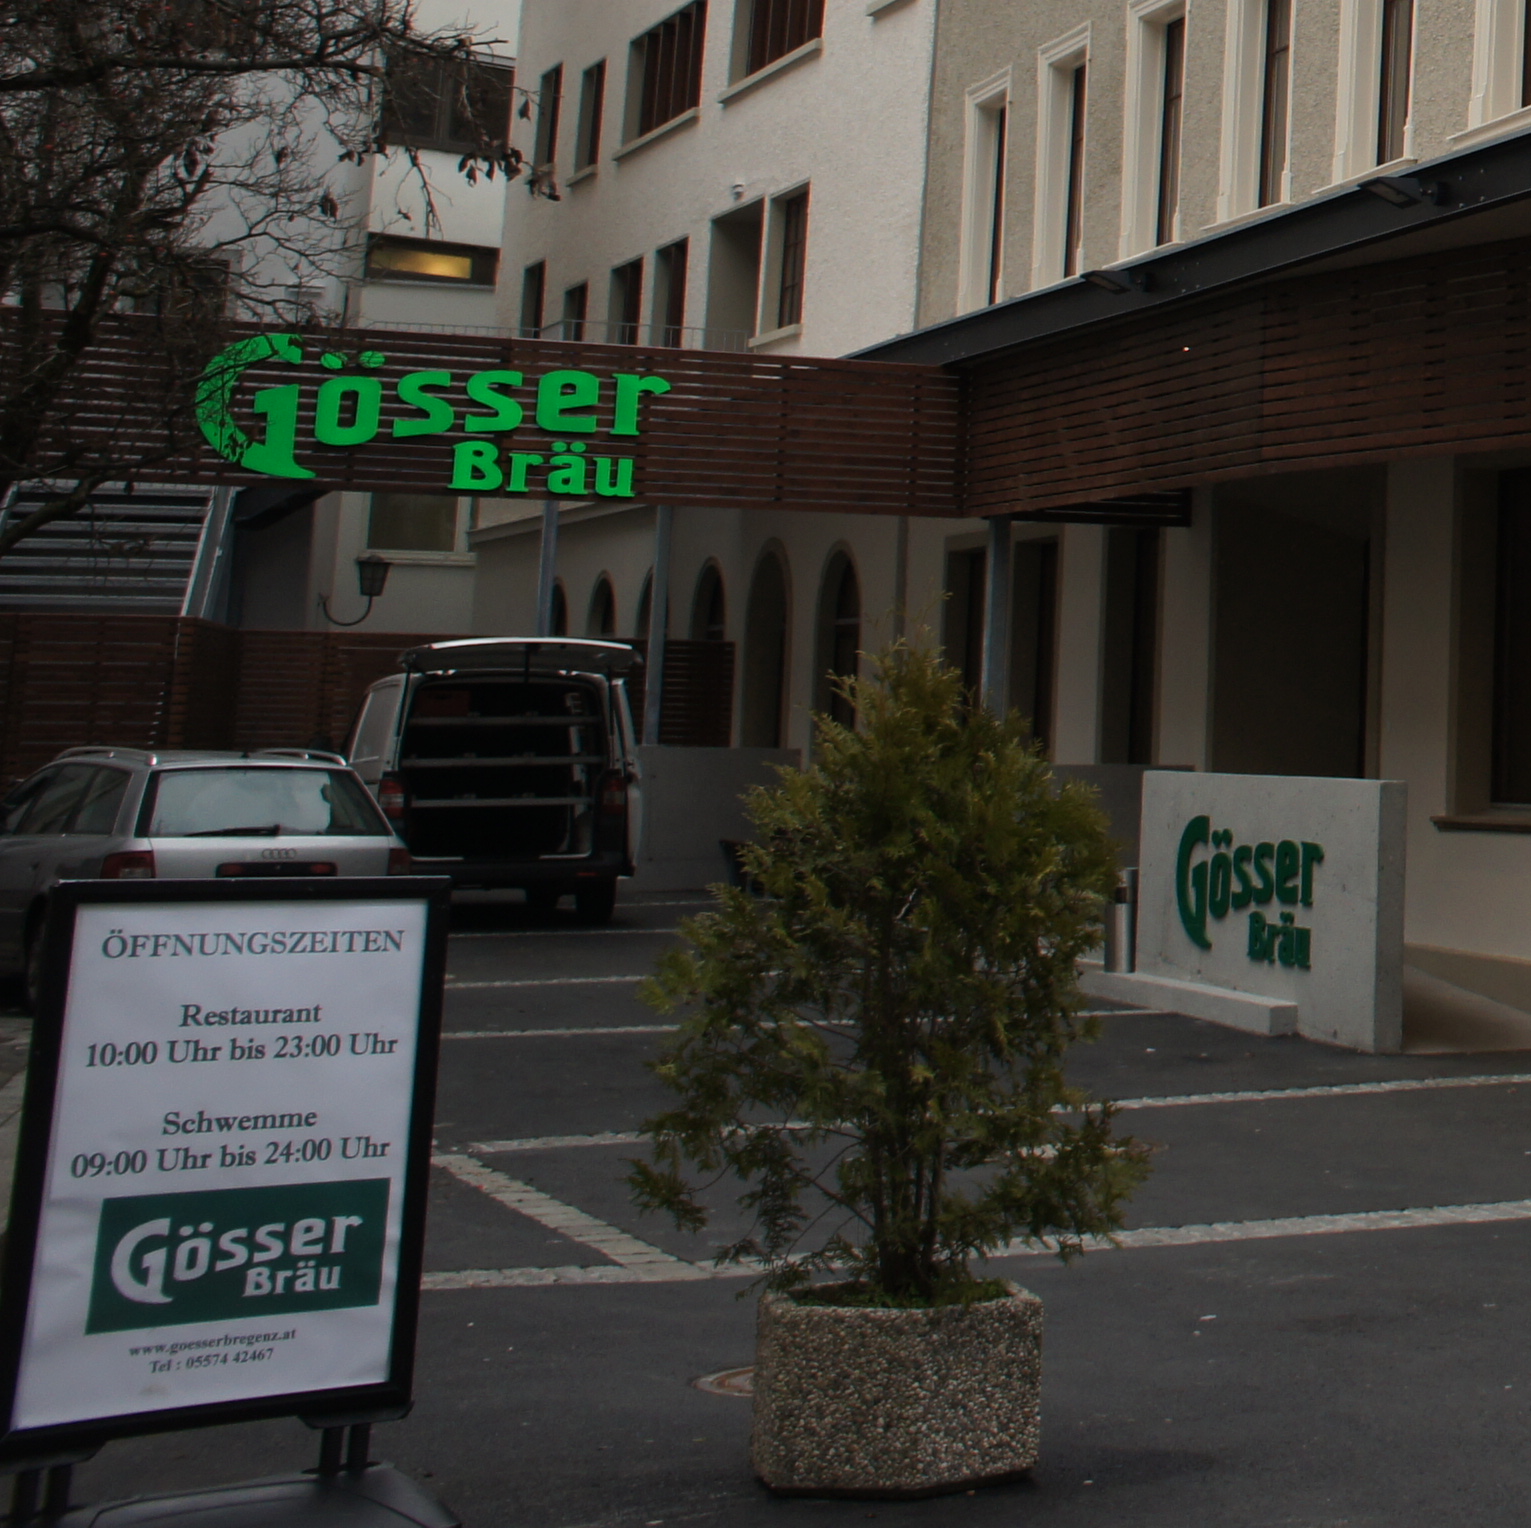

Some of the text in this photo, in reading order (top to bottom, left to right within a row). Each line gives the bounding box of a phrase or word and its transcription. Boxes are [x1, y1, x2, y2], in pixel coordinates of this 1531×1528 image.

[196, 333, 671, 480] Gösser
[448, 441, 636, 498] Bräu
[1176, 814, 1325, 950] Gösser
[102, 928, 405, 958] ÖFFNUNGSZEITEN
[1247, 911, 1312, 970] Bräu
[180, 1003, 322, 1028] Restaurant
[86, 1033, 398, 1068] 10:00 Uhr bis 23:00 Uhr
[163, 1108, 318, 1136] Schwemme
[70, 1135, 392, 1179] 09:00 Uhr bis 24:00 Uhr
[111, 1214, 364, 1305] Gösser
[242, 1263, 341, 1298] Bräu
[129, 1328, 297, 1357] www.goesserbregenz.at
[186, 1355, 228, 1370] 05574
[232, 1347, 274, 1364] 42467
